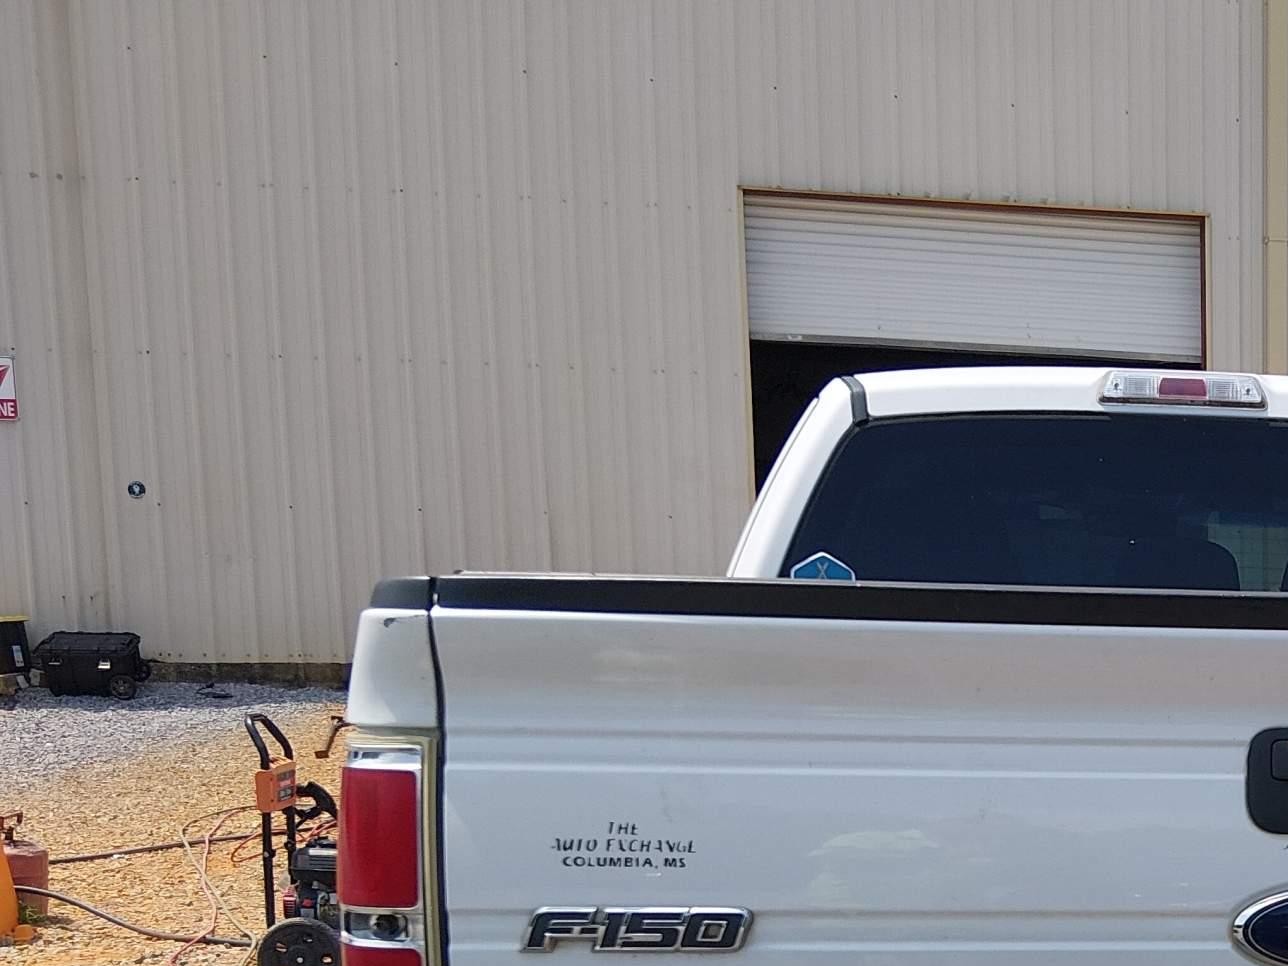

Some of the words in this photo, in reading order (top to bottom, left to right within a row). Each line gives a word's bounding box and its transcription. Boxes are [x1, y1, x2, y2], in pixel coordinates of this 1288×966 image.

[608, 821, 639, 835] THE
[663, 857, 687, 868] MS
[519, 905, 754, 953] F-150
